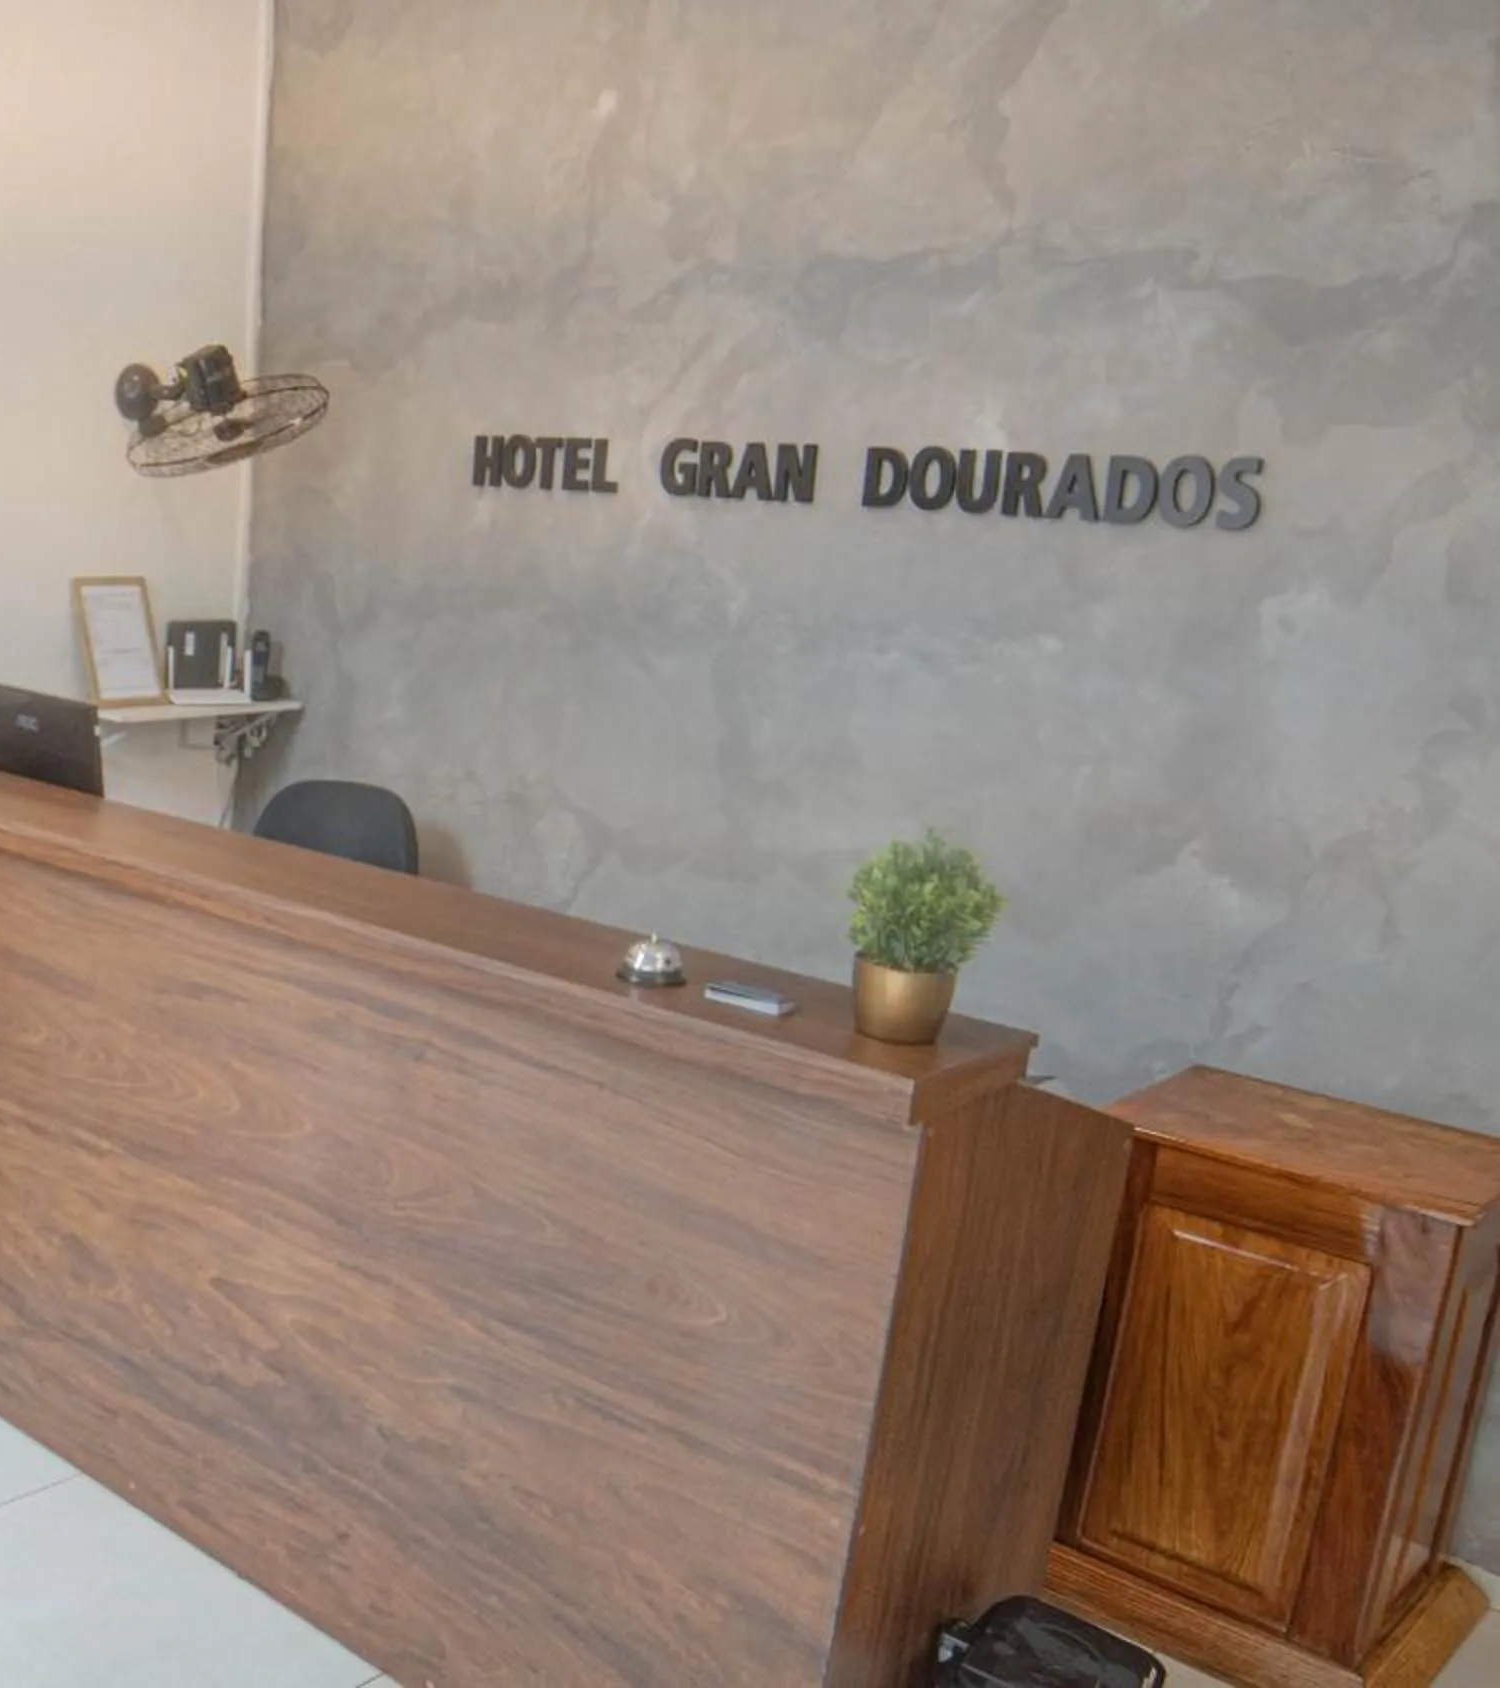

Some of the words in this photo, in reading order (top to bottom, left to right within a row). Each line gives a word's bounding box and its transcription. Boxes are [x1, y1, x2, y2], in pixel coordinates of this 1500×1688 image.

[473, 434, 618, 493] HOTEL
[660, 437, 819, 503] GRAN
[862, 446, 1265, 531] DOURADOS
